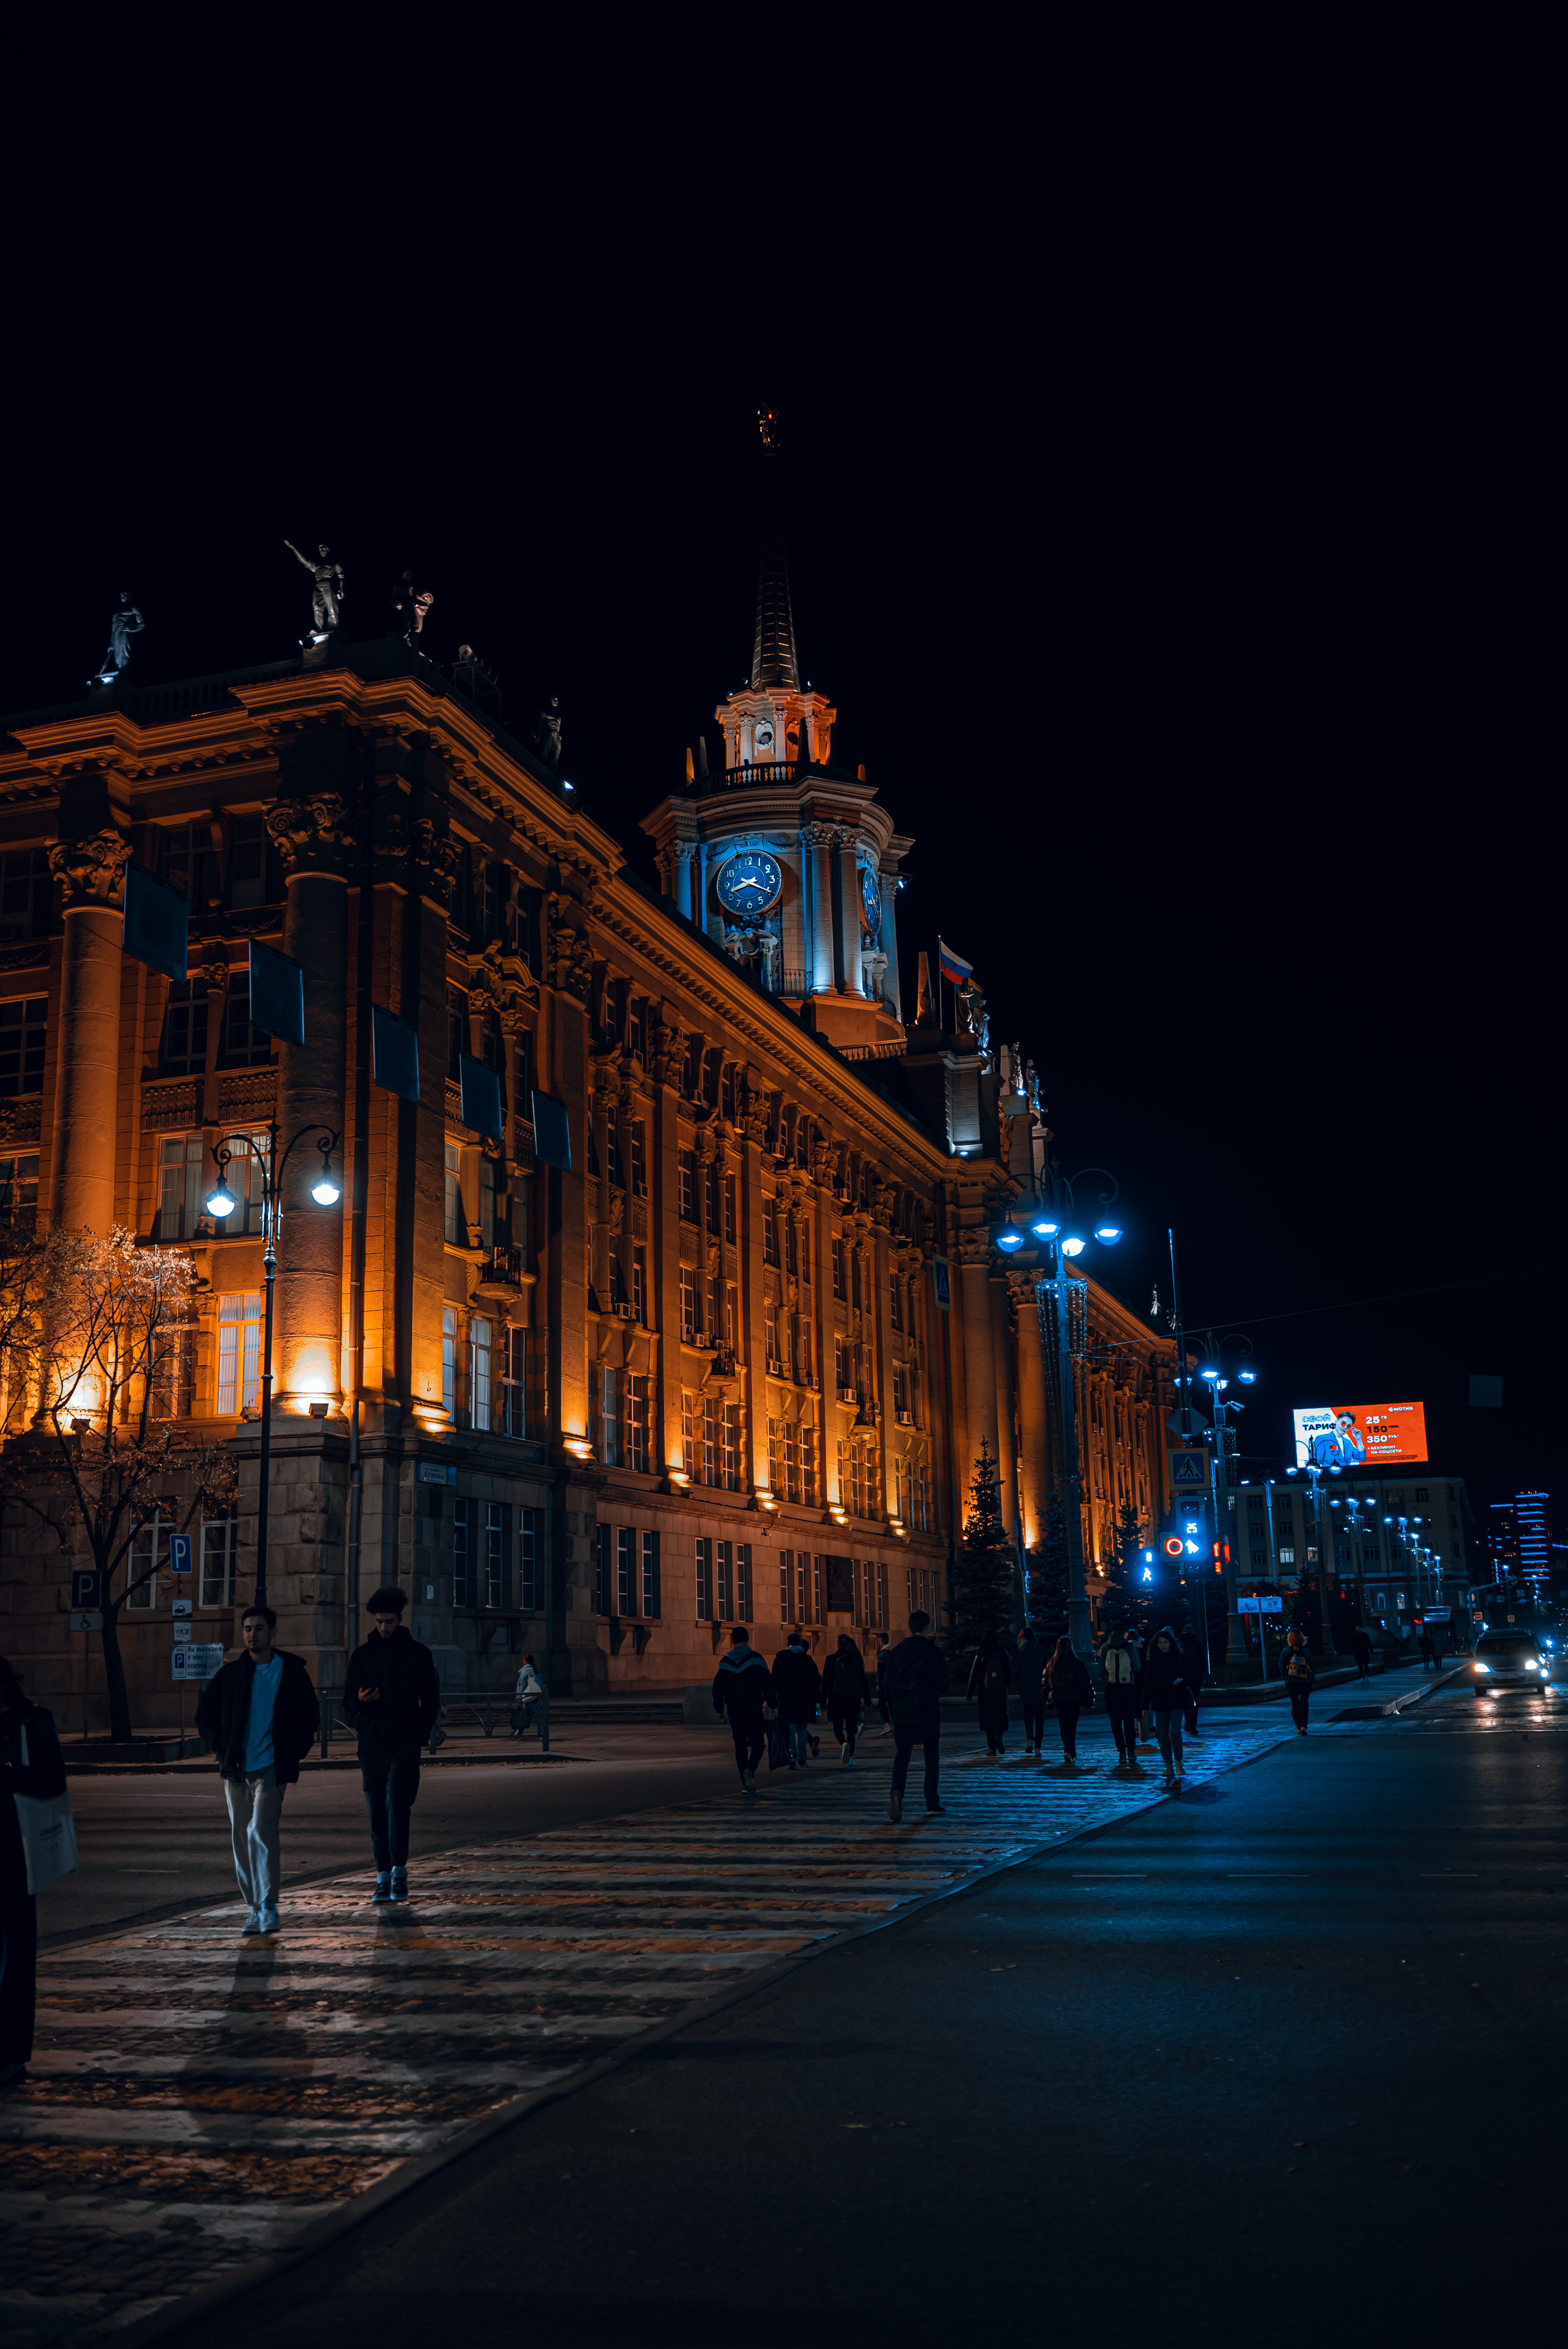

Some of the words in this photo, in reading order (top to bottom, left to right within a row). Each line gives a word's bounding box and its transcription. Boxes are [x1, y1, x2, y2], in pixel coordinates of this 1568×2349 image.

[745, 857, 752, 866] 12
[758, 857, 761, 866] 1
[726, 869, 734, 878] 10
[765, 864, 771, 874] 2
[769, 875, 775, 883] 3
[728, 892, 734, 901] 8
[758, 896, 764, 905] 5
[736, 899, 742, 907] 7
[747, 901, 753, 909] 6
[1302, 1413, 1331, 1422] СВОЙ
[1365, 1415, 1380, 1424] 25
[1302, 1422, 1336, 1431] ТАРИФ
[1366, 1435, 1388, 1443] 350
[175, 1538, 186, 1568] P
[78, 1575, 94, 1605] P
